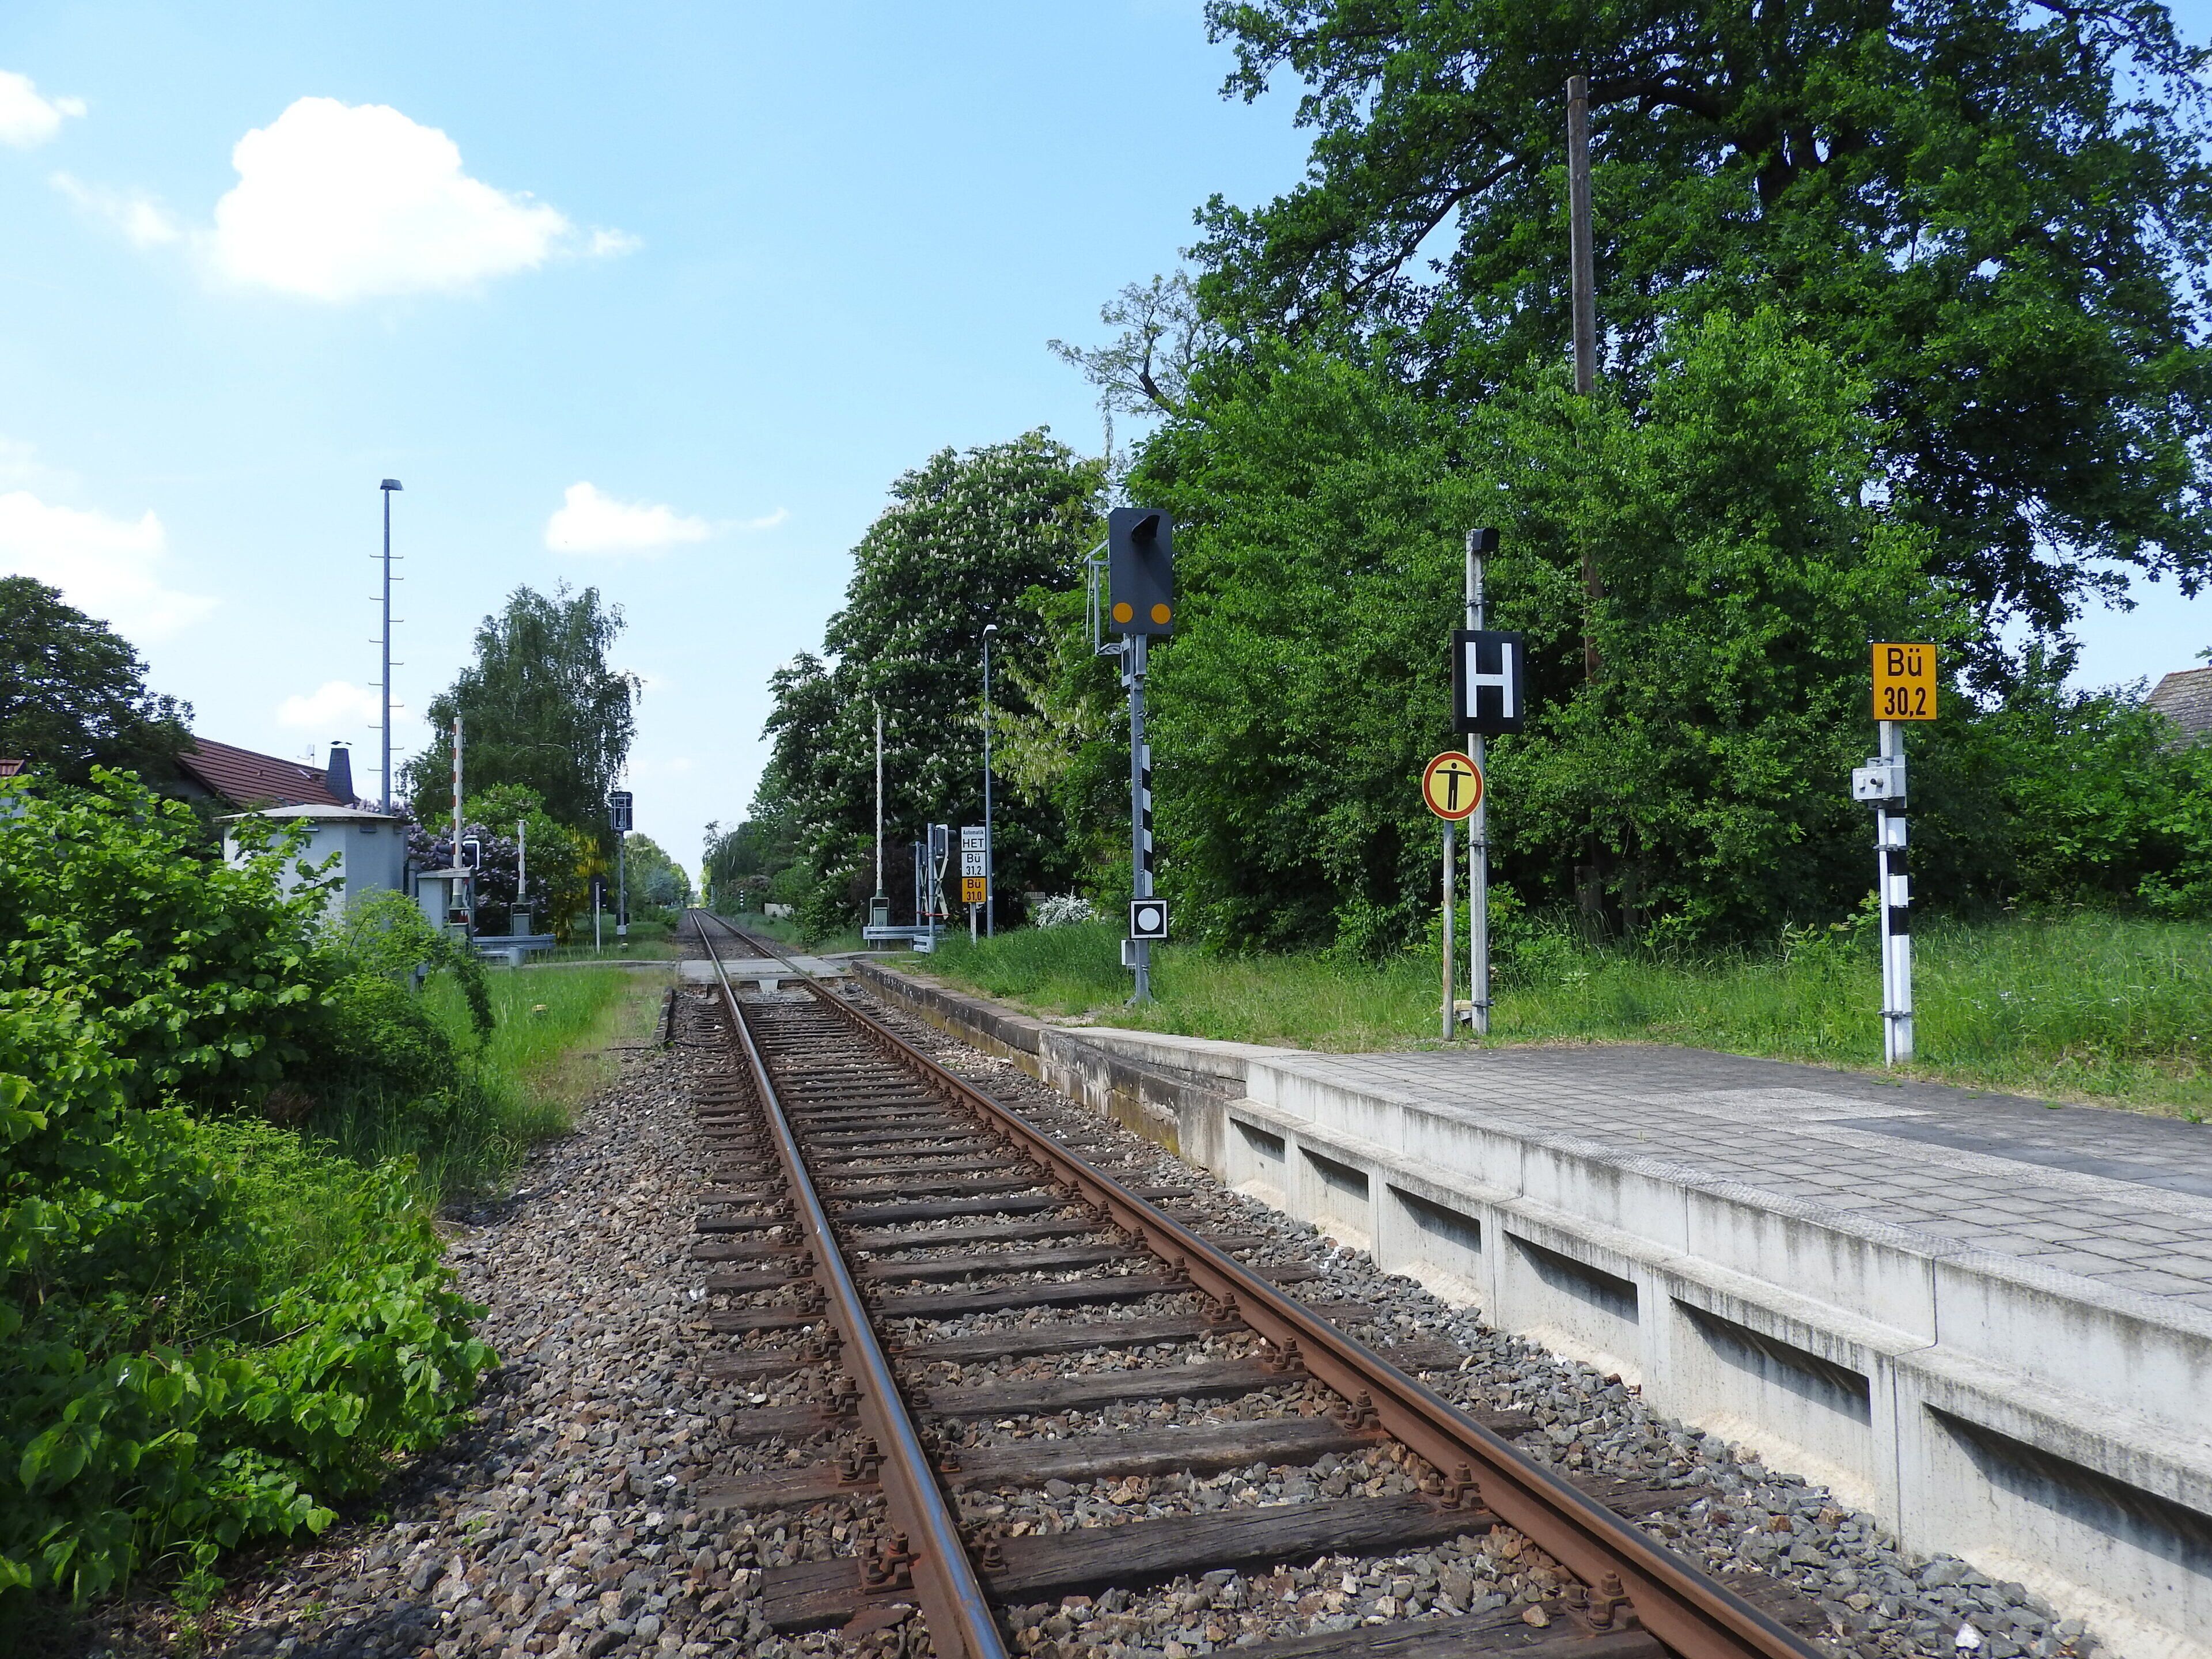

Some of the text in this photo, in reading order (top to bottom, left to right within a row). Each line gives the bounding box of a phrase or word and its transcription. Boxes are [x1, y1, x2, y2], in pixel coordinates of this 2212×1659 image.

[1888, 648, 1922, 676] Bü
[1465, 642, 1513, 717] H
[963, 839, 984, 847] HET
[967, 854, 980, 862] Bü
[968, 879, 980, 888] Bü
